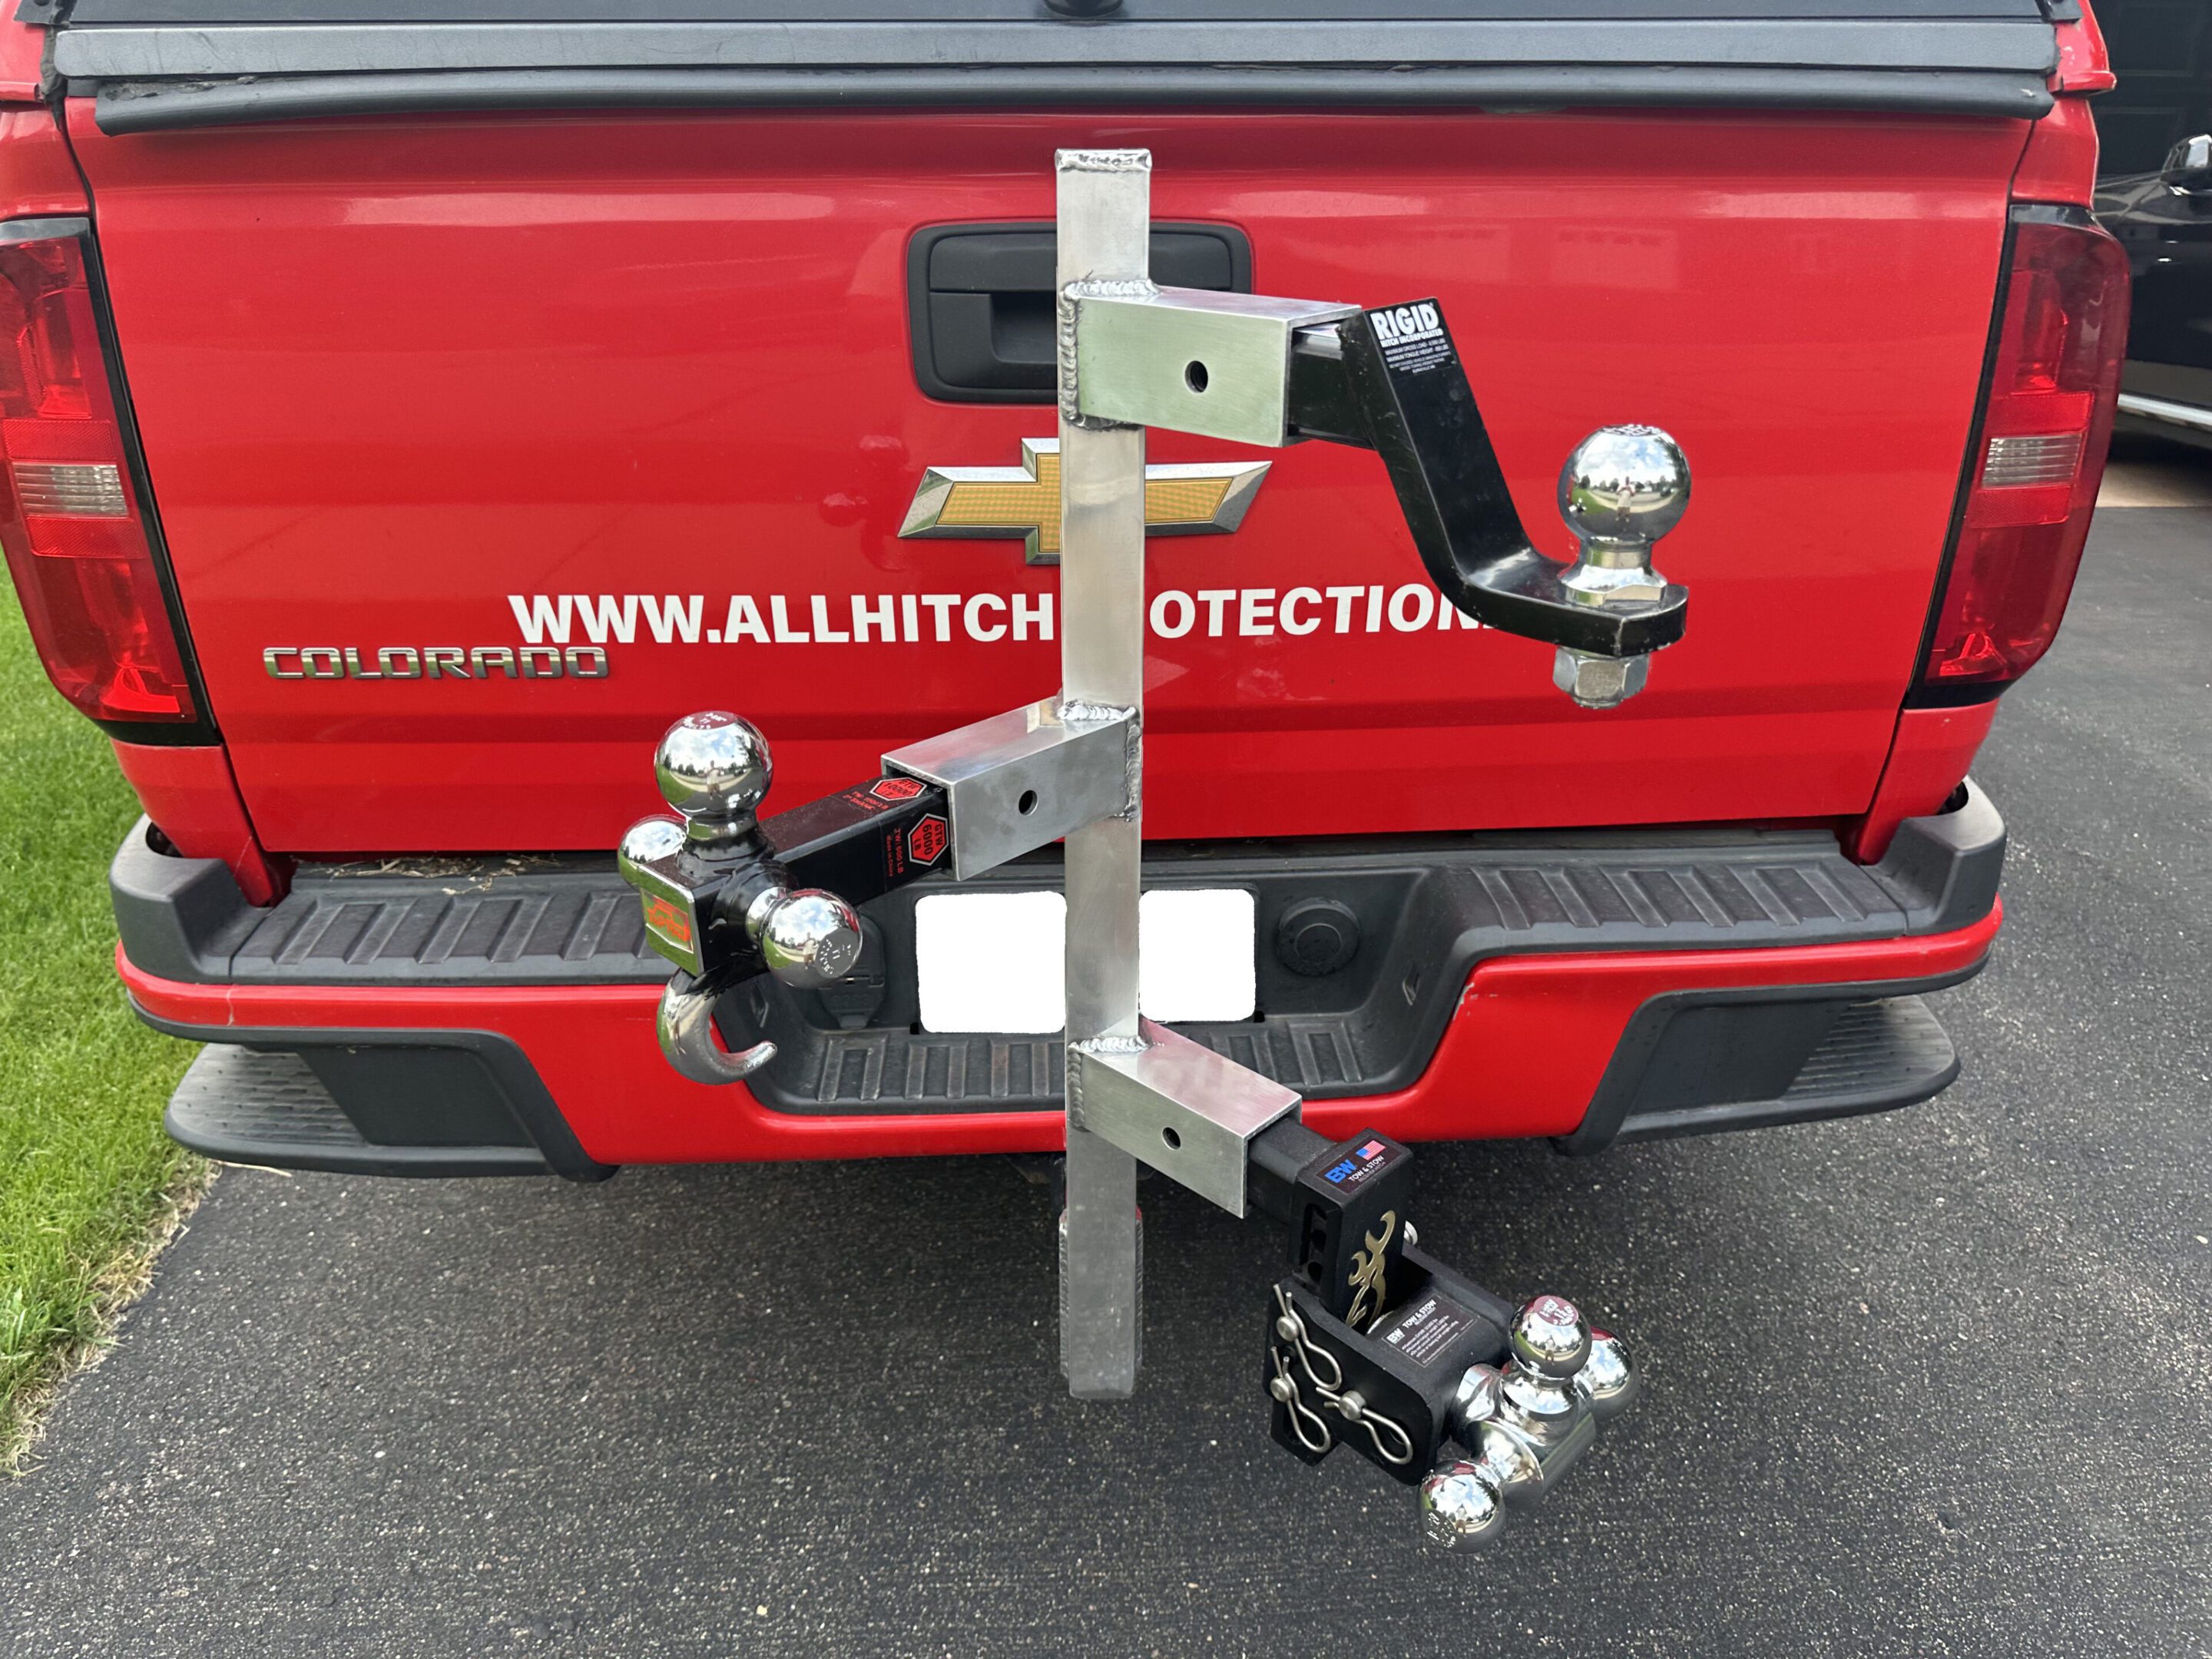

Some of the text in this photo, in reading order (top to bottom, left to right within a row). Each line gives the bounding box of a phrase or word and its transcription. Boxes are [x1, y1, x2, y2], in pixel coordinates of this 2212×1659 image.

[1370, 303, 1439, 339] RIGID
[263, 647, 610, 680] COLORADO
[913, 838, 922, 851] LB
[922, 824, 934, 856] 6000
[934, 823, 944, 846] GTW
[1348, 1169, 1365, 1181] TOW
[1366, 1154, 1385, 1169] STOW
[1402, 1315, 1417, 1329] TOW
[1419, 1299, 1437, 1314] STOW
